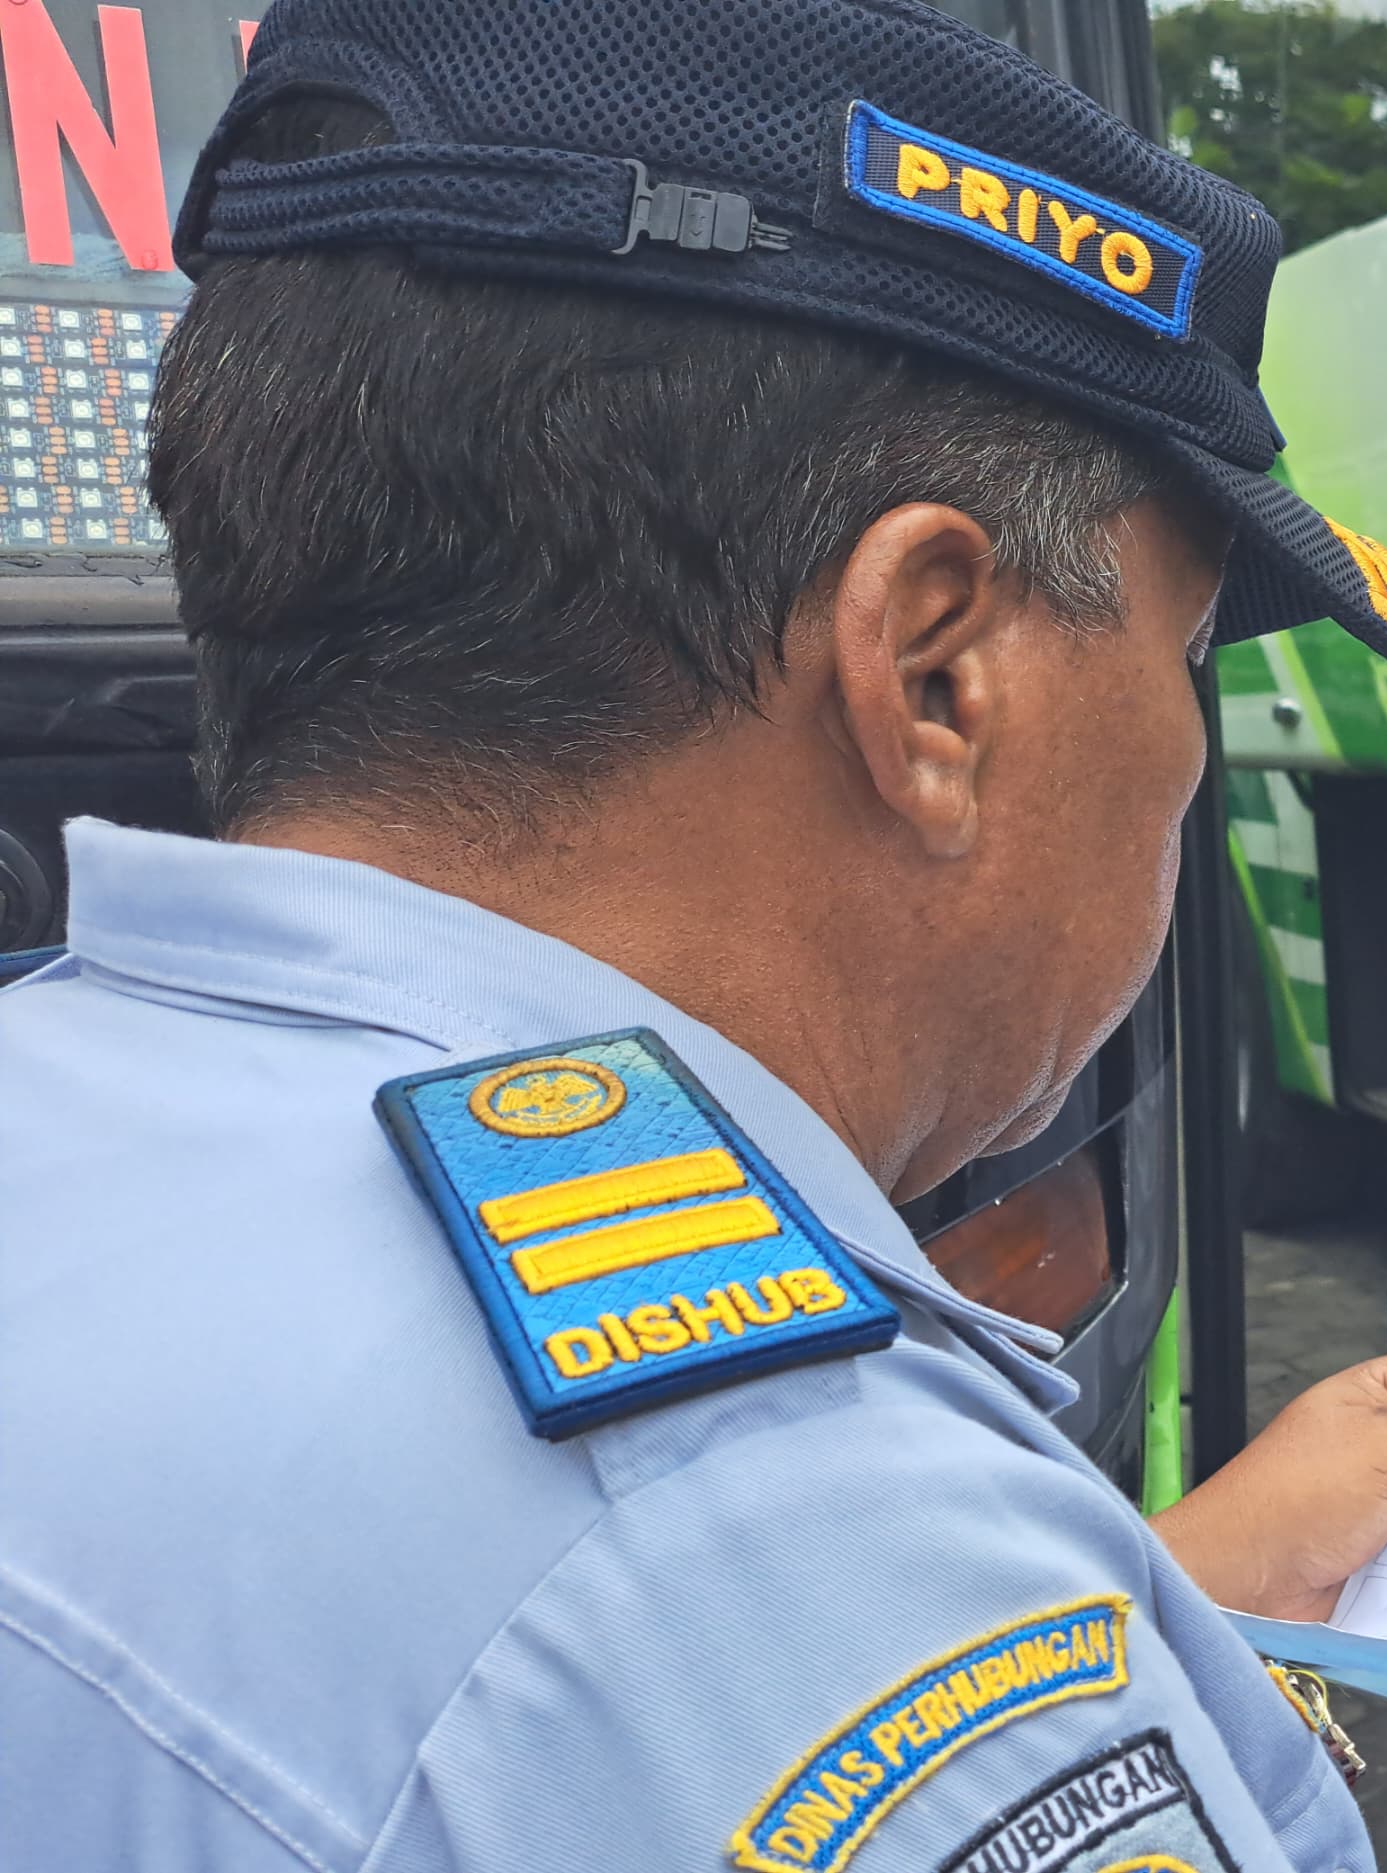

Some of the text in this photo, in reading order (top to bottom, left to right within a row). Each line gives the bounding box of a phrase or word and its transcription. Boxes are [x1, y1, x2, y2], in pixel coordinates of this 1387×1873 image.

[897, 143, 1154, 296] PRIYO
[544, 1267, 847, 1379] DISHUB
[768, 1618, 1109, 1863] DINAS PERHUBUNGAN
